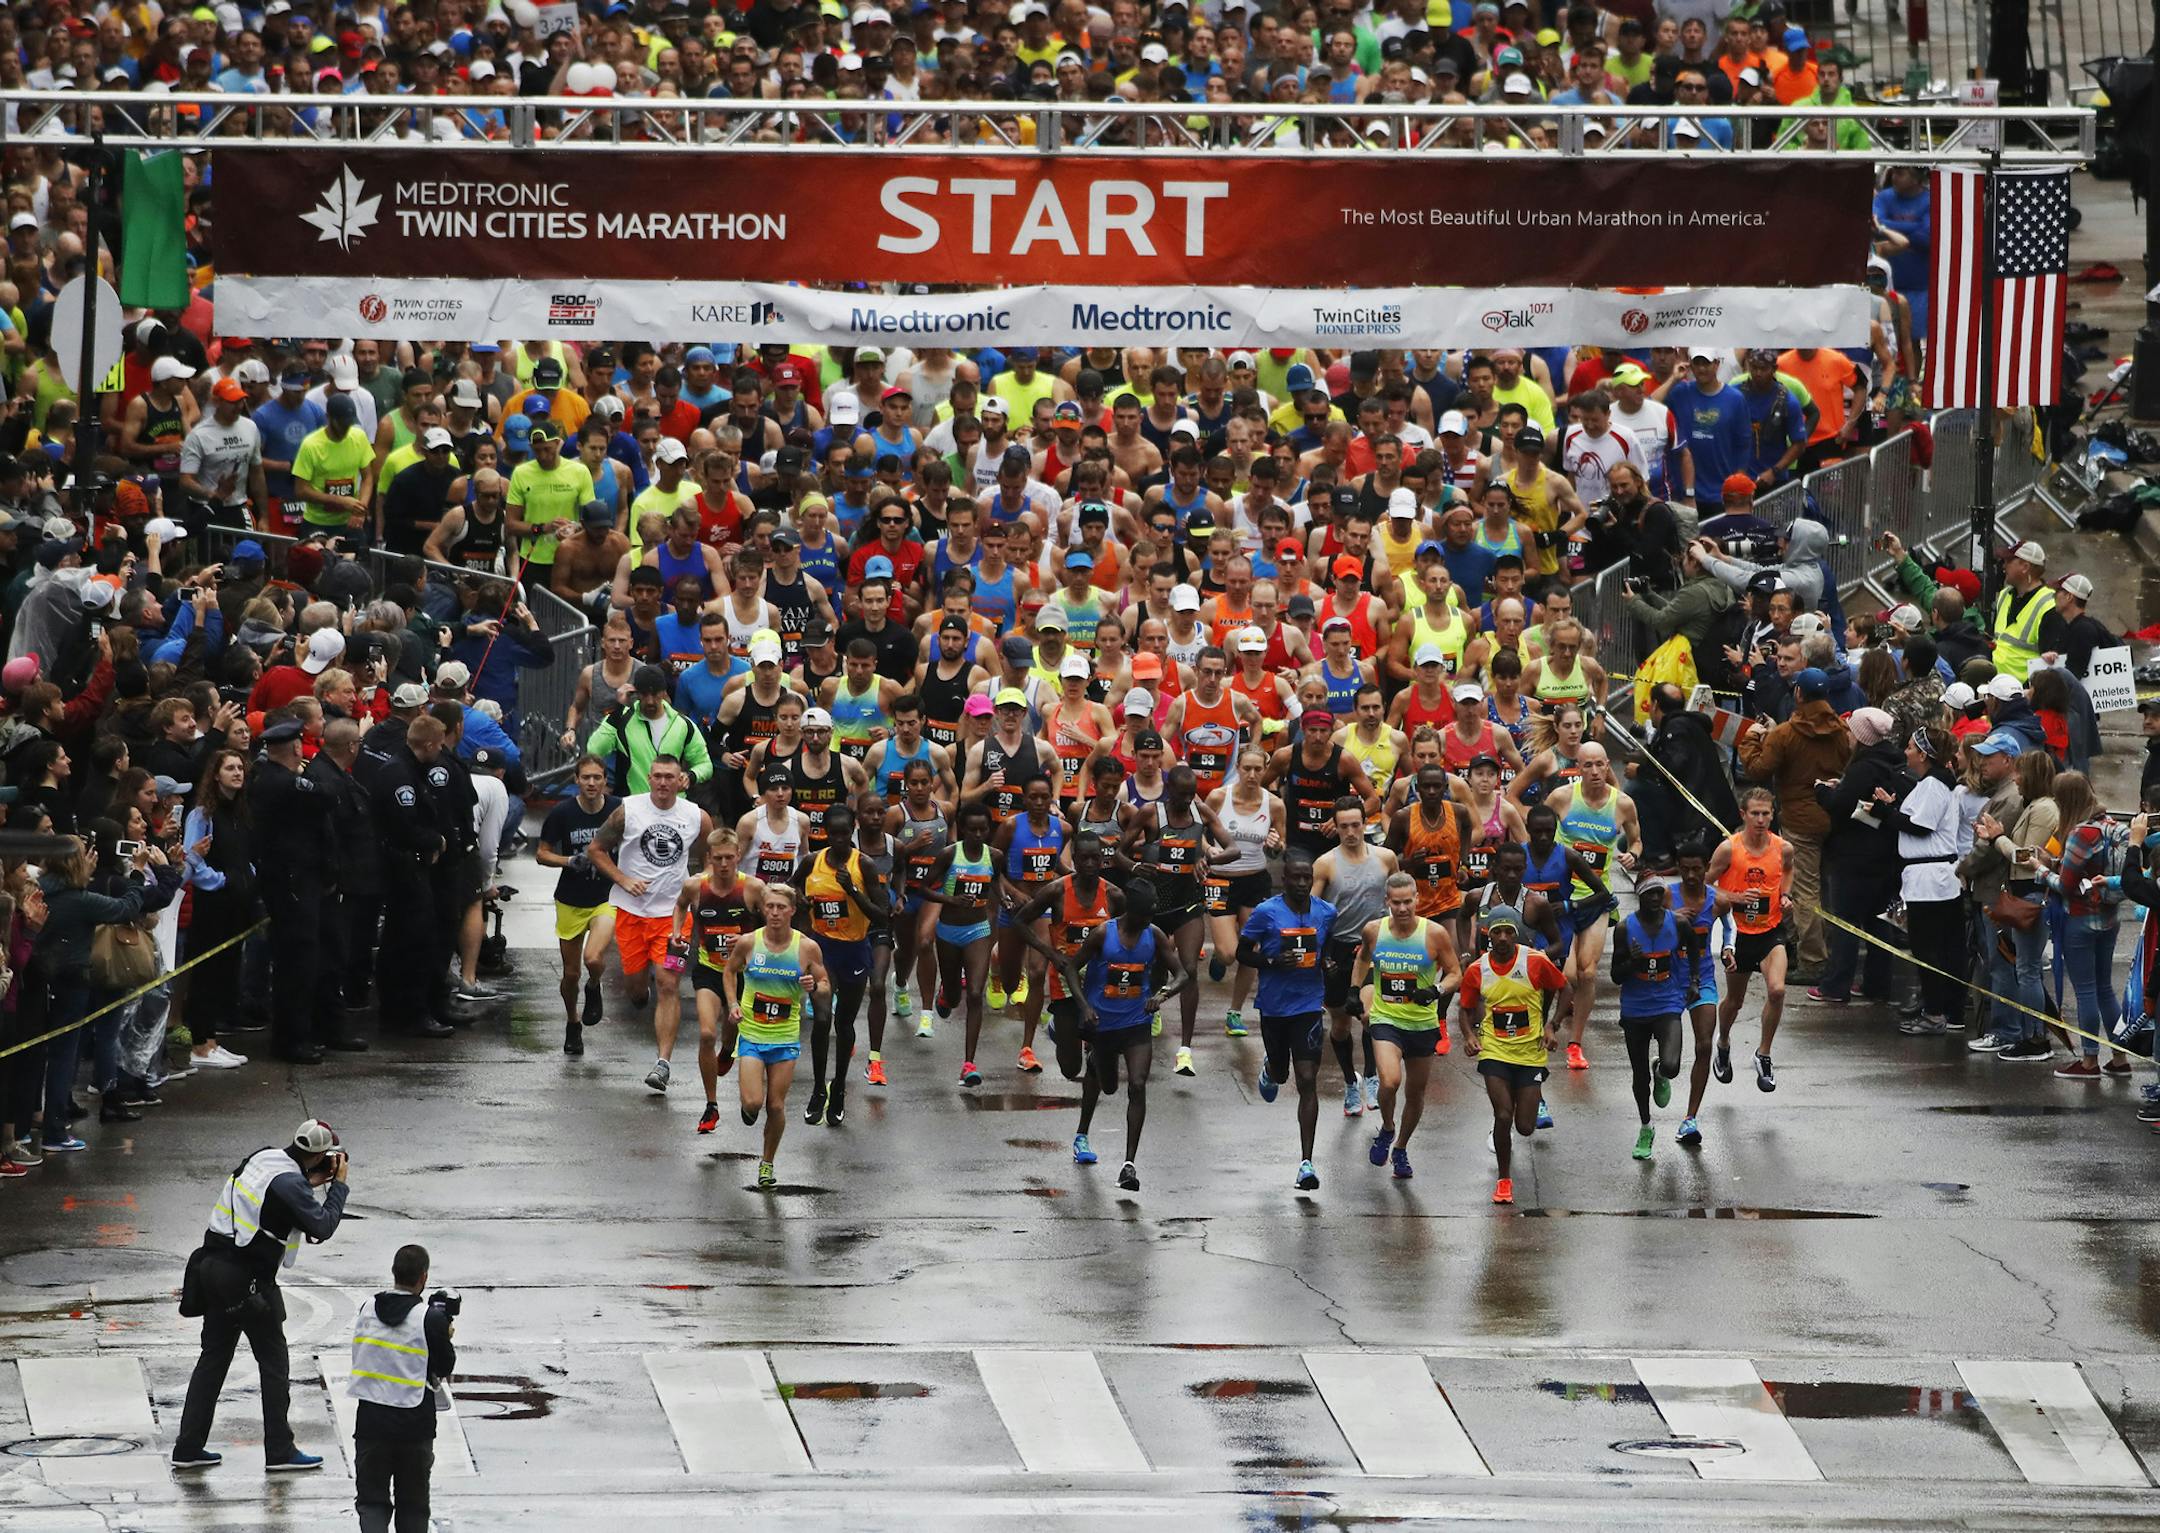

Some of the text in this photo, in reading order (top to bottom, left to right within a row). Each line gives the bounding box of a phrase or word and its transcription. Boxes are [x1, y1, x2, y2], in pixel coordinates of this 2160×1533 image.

[1970, 87, 1985, 99] NO
[396, 182, 569, 206] MEDTRONIC
[876, 176, 1230, 257] START
[1341, 208, 1374, 225] The
[1380, 209, 1424, 225] Most
[1430, 208, 1511, 226] Beautiful
[1517, 209, 1572, 226] Urban
[1577, 210, 1662, 226] Marathon
[1668, 210, 1684, 226] in
[396, 211, 786, 240] TWIN CITIES MARATHON
[393, 299, 463, 309] TWIN CITIES
[551, 295, 587, 306] 1500
[392, 312, 456, 321] IN MOTION
[549, 305, 596, 317] ESPN
[692, 305, 747, 323] KARE
[1072, 303, 1232, 331] Medtronic
[1313, 308, 1402, 323] TwinCities
[1655, 306, 1723, 320] TWIN CITIES
[850, 305, 1011, 333] Medtronic
[1654, 319, 1716, 329] IN MOTION
[1315, 324, 1401, 335] PIONEER PRESS
[2094, 662, 2127, 676] FOR:
[2092, 686, 2131, 699] Athletes
[2095, 698, 2134, 711] Athletes
[931, 729, 954, 743] 1481
[850, 745, 864, 756] 34
[1201, 754, 1215, 766] 53
[1309, 807, 1322, 819] 51
[1577, 821, 1612, 834] BROOKS
[1031, 850, 1051, 863] 102
[1170, 847, 1185, 860] 32
[1469, 853, 1488, 864] 114
[1583, 851, 1596, 864] 59
[761, 860, 790, 872] 3904
[1429, 863, 1438, 875] 5
[964, 882, 983, 894] 101
[820, 901, 840, 914] 105
[1081, 926, 1090, 939] 6
[1296, 936, 1302, 948] 1
[1385, 951, 1423, 960] BROOKS
[759, 967, 797, 977] BROOKS
[1380, 959, 1395, 970] Run
[1403, 960, 1419, 972] Fun
[1121, 971, 1130, 983] 2
[765, 1003, 780, 1015] 16
[1505, 1012, 1514, 1025] 7
